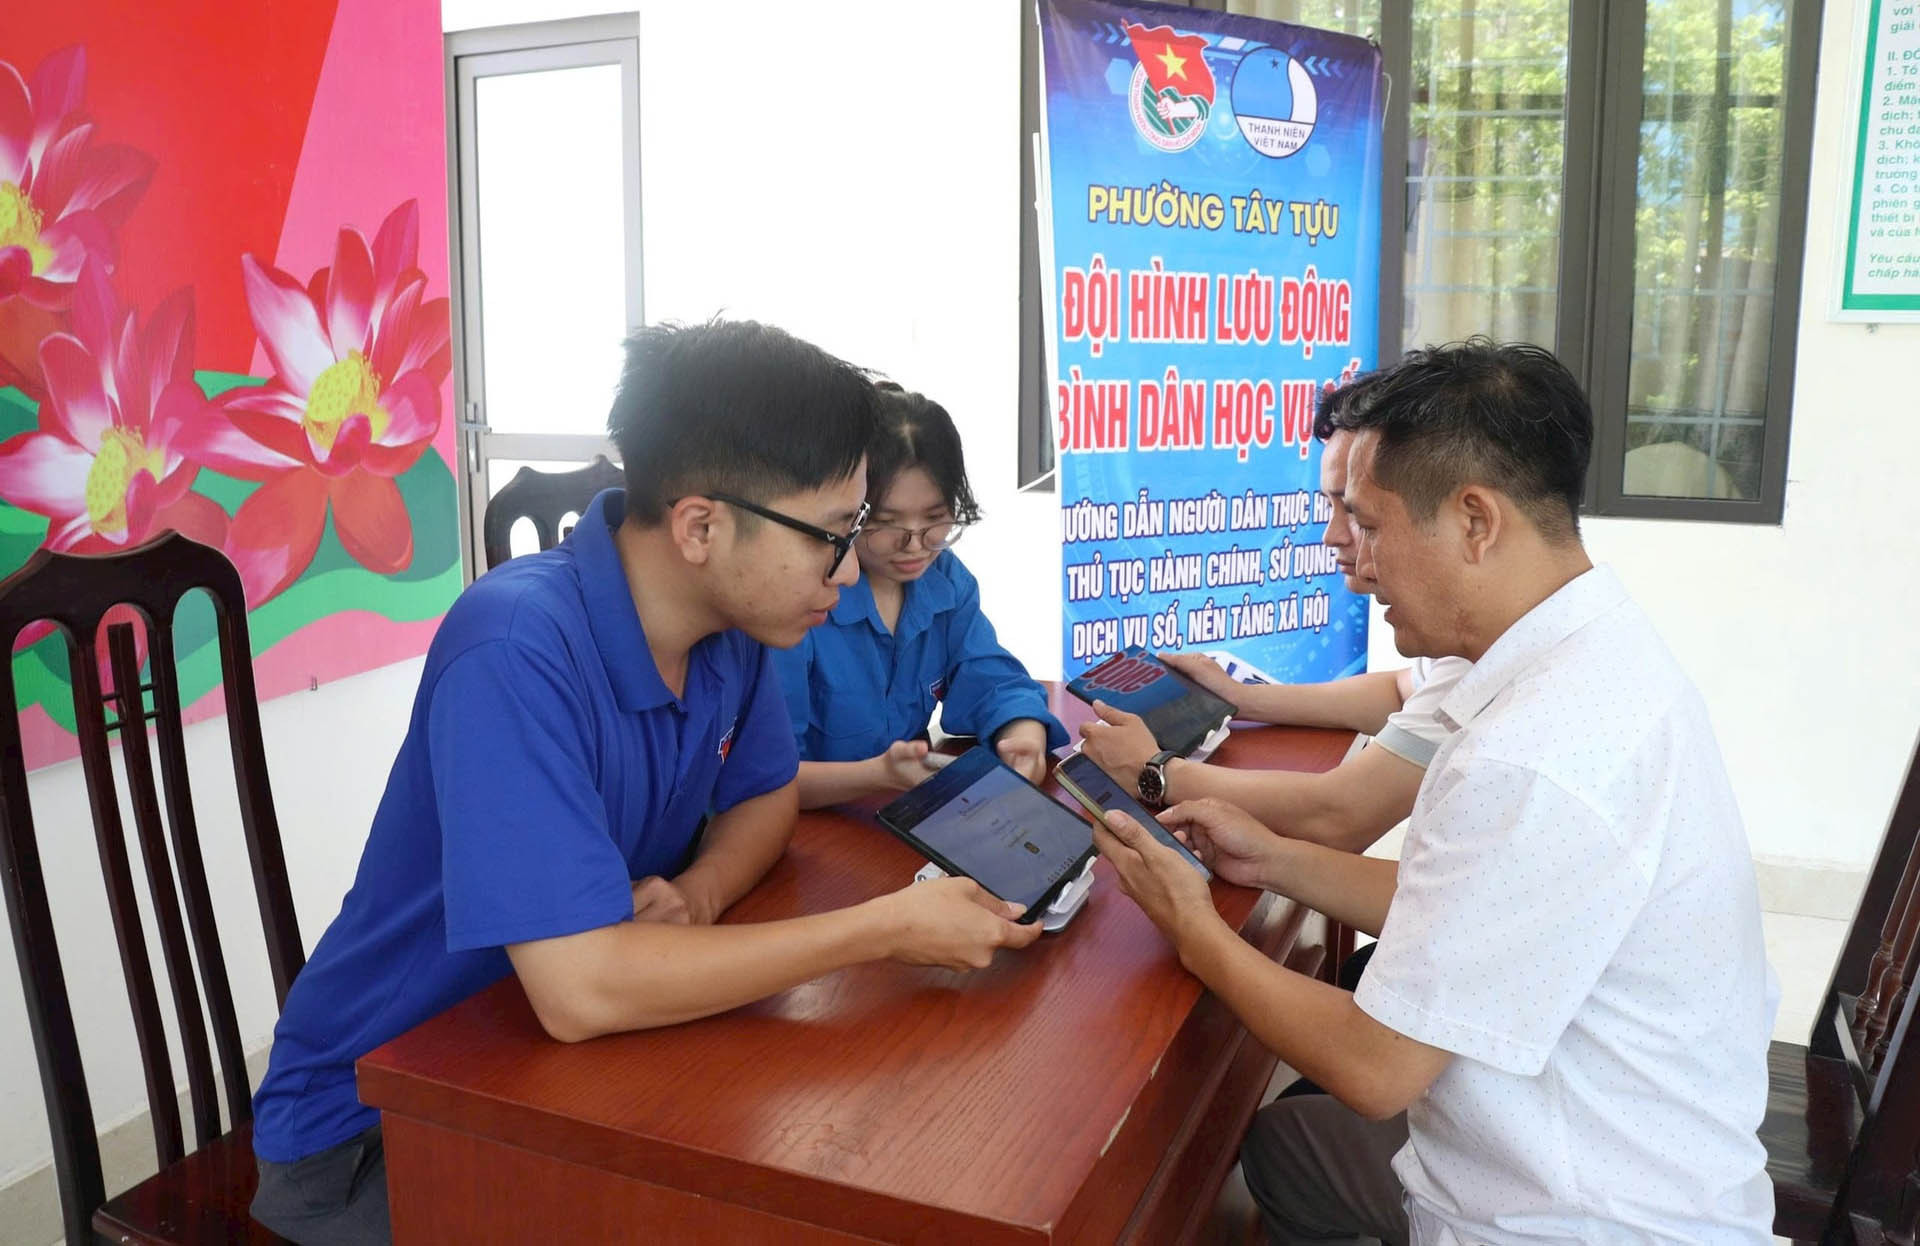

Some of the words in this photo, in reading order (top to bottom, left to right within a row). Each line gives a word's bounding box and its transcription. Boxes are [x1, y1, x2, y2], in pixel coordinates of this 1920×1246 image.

[1248, 122, 1281, 136] THANH
[1283, 126, 1305, 138] NIÊN
[1278, 140, 1298, 150] NAM
[1088, 179, 1225, 232] PHƯỜNG
[1231, 188, 1283, 235] TÂY
[1290, 200, 1340, 246] TỰU
[1062, 256, 1120, 356] ĐỘI
[1128, 258, 1208, 343] HÌNH
[1215, 271, 1273, 344] LƯU
[1279, 266, 1351, 357] ĐỘNG
[1057, 367, 1130, 452] BÌNH
[1137, 367, 1206, 449] DÂN
[1213, 381, 1275, 460] HỌC
[1281, 381, 1317, 458] VỤ
[1061, 497, 1119, 542] ƯỚNG
[1122, 488, 1165, 539] DẪN
[1168, 489, 1227, 535] NGƯỜI
[1229, 488, 1269, 532] DÂN
[1271, 488, 1311, 534] THỰC
[1066, 550, 1104, 603] THỦ
[1107, 557, 1145, 604] TỤC
[1149, 548, 1203, 593] HÀNH
[1206, 543, 1265, 588] CHÍNH,
[1268, 535, 1293, 581] SỬ
[1292, 541, 1339, 584] DỤNG
[1072, 617, 1119, 664] DỊCH
[1151, 599, 1184, 650] SỐ,
[1187, 597, 1227, 644] NỀN
[1230, 593, 1275, 639] TẢNG
[1277, 591, 1299, 633] XÃ
[1302, 588, 1330, 635] HỘI
